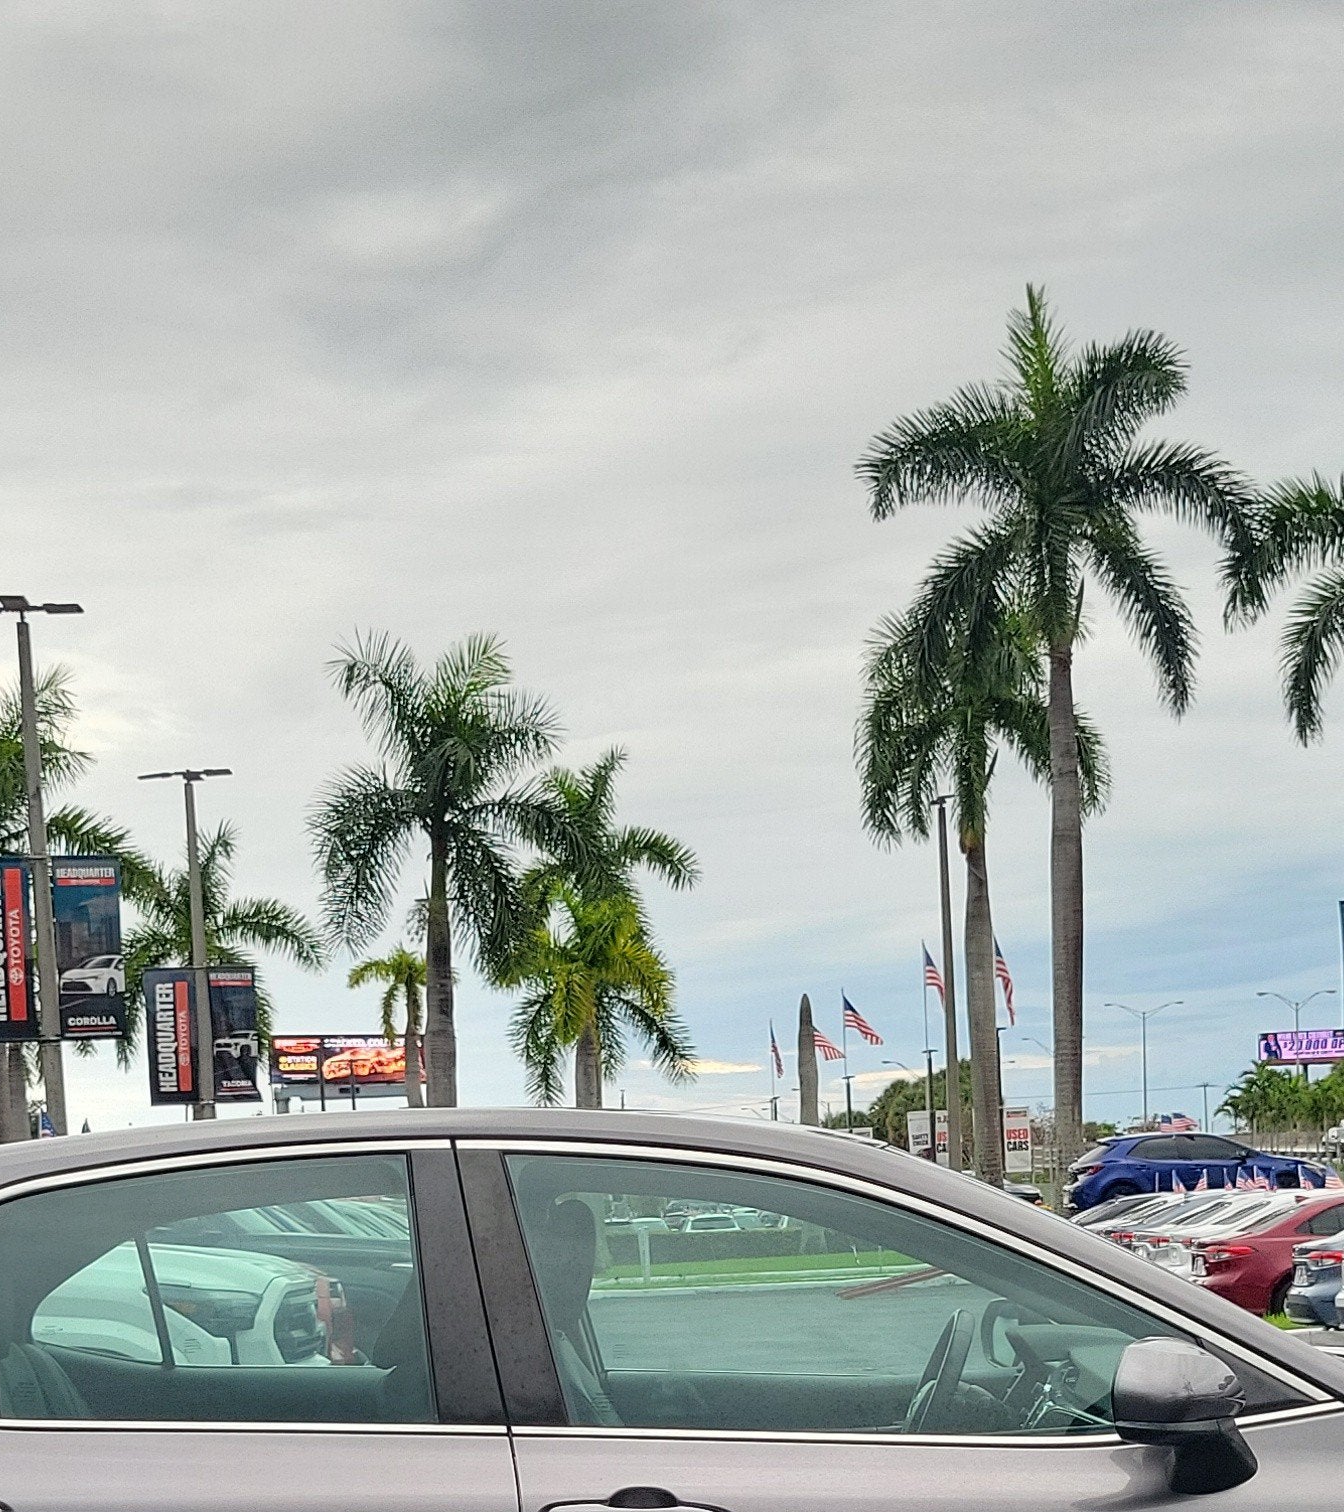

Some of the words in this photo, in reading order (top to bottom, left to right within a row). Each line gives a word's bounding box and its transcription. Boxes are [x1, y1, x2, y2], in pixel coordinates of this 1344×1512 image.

[56, 867, 115, 879] HEADQUARTER
[10, 909, 23, 966] TOYOTA
[67, 1015, 117, 1027] COROLLA
[155, 982, 178, 1092] HEADQUARTER
[1006, 1129, 1028, 1140] USED
[1006, 1140, 1029, 1151] CARS
